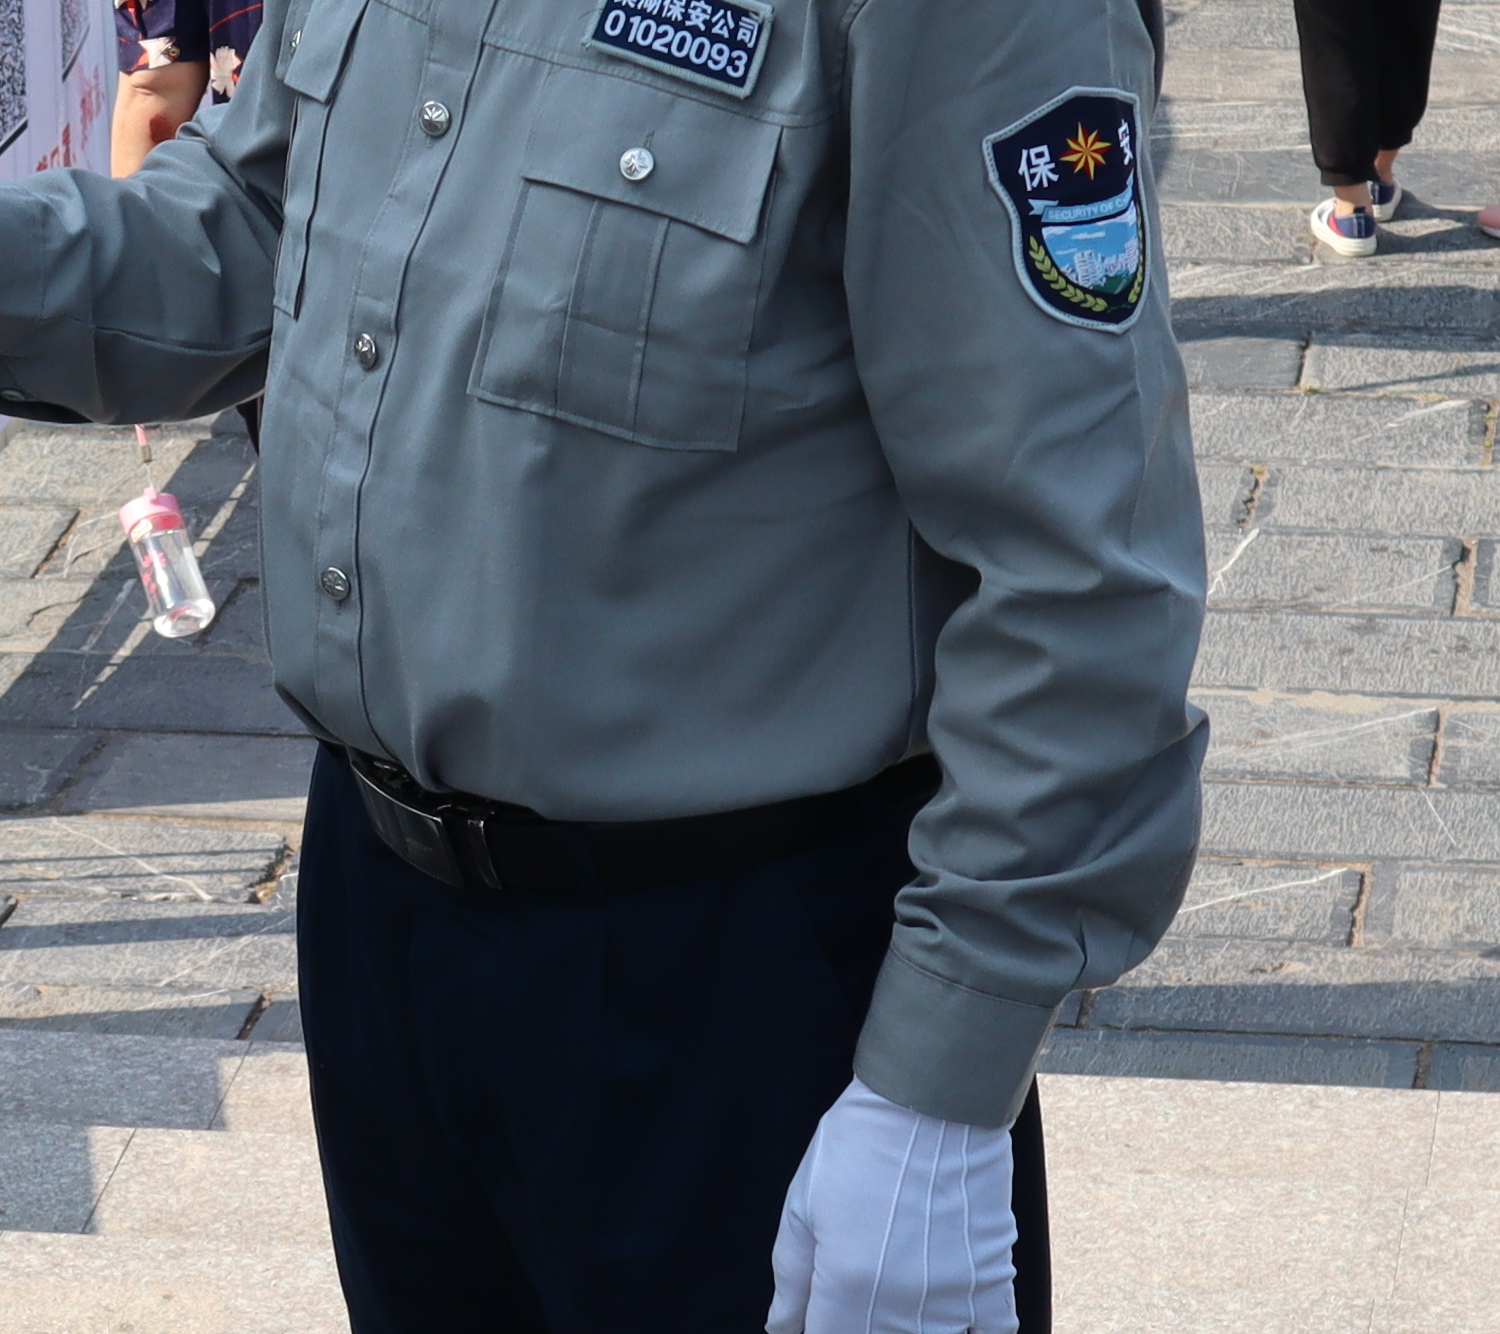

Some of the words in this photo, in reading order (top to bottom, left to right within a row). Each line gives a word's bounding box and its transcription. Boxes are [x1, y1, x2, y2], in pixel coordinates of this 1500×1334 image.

[603, 8, 749, 79] 01020093
[1017, 144, 1060, 192] 保
[1048, 204, 1099, 221] SECURITY
[1099, 201, 1115, 214] OF
